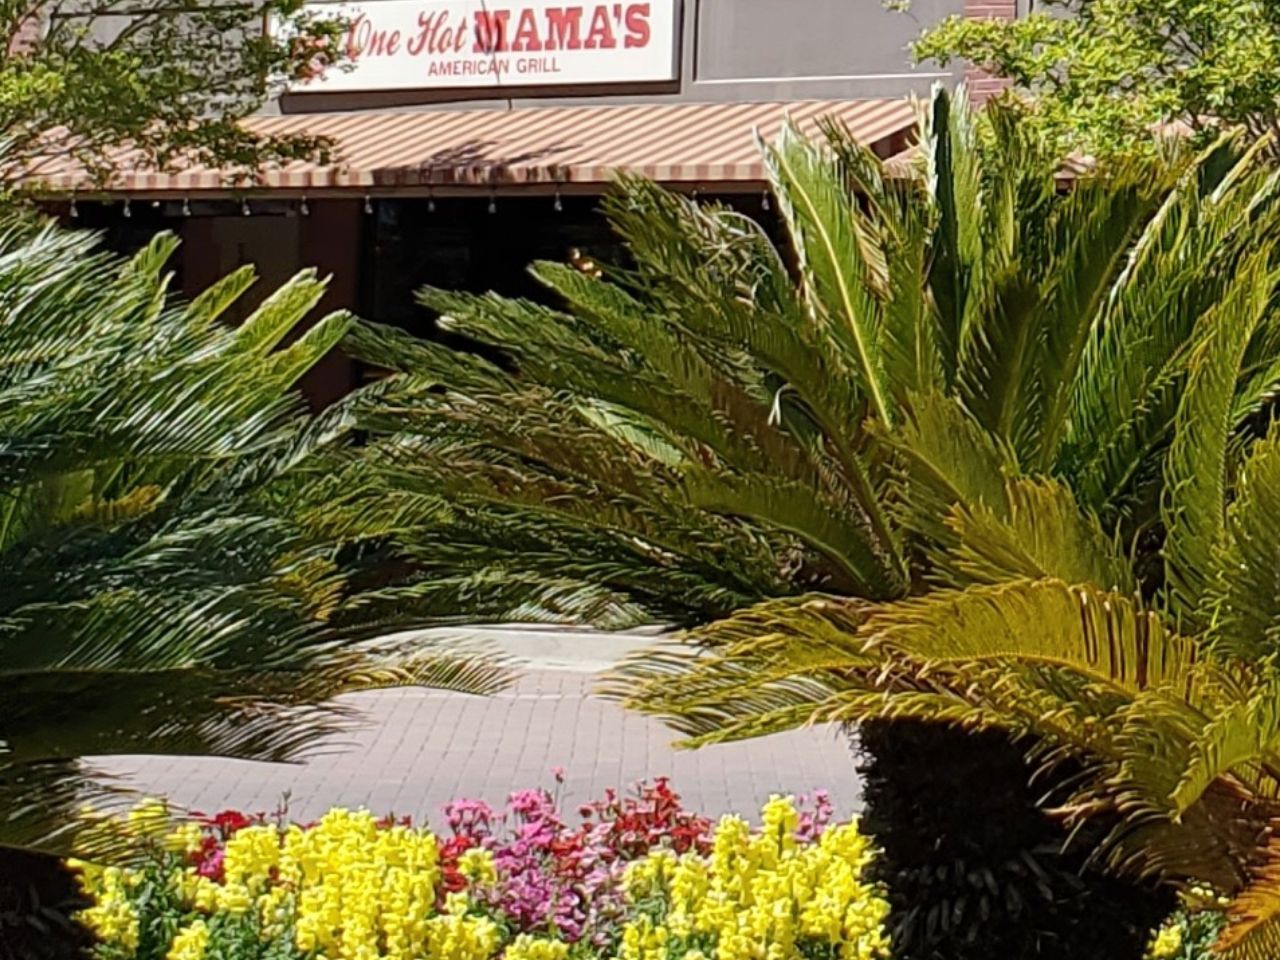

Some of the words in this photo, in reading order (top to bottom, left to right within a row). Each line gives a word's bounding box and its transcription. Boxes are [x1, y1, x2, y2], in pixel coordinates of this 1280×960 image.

[346, 12, 401, 60] One
[407, 10, 467, 56] Hot
[472, 3, 651, 54] MAMA'S
[427, 58, 510, 77] AMERICAN
[517, 57, 561, 74] GRILL
